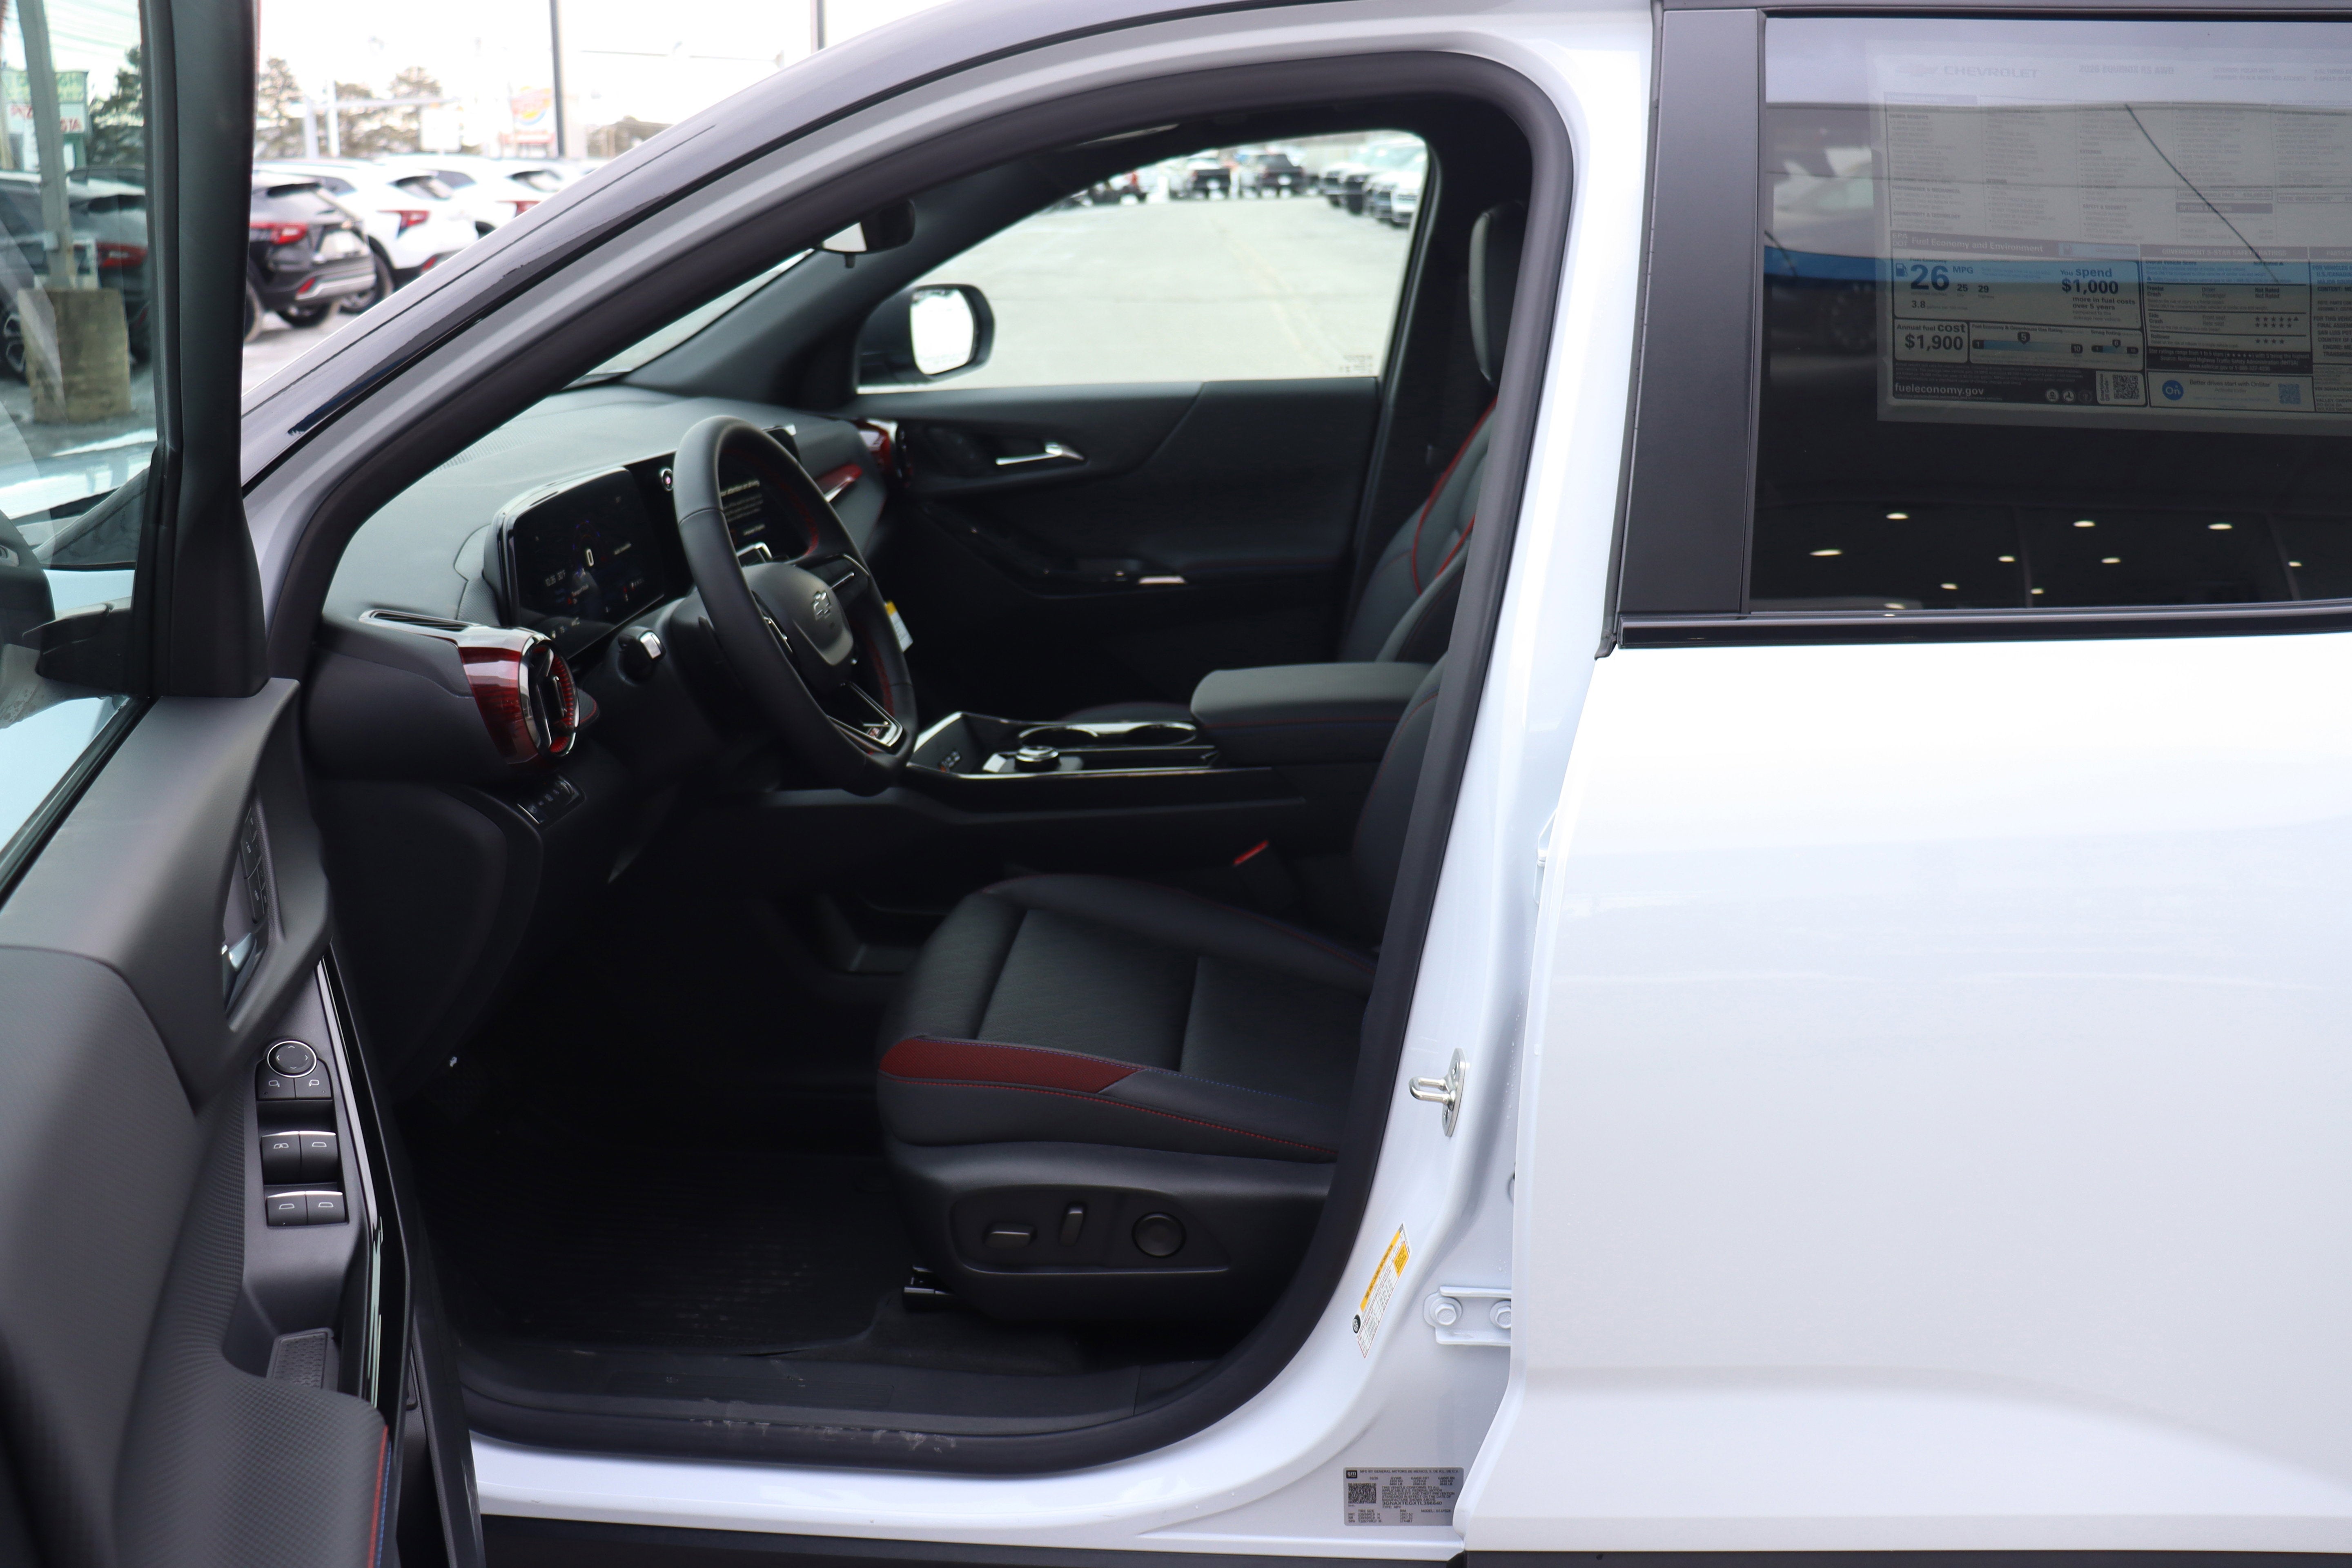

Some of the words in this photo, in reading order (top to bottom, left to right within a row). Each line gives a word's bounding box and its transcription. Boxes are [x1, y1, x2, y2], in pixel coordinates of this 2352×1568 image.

[1944, 65, 2040, 78] CHEVROLET
[2079, 65, 2100, 73] 2026
[2102, 65, 2139, 74] EQUINOX
[2154, 66, 2174, 75] AWD
[1931, 238, 1969, 249] Economy
[1973, 241, 1988, 249] and
[1990, 241, 2043, 252] Environment
[1910, 264, 1950, 292] 26
[1952, 266, 1974, 274] MPG
[2060, 268, 2074, 276] You
[2075, 268, 2113, 278] spend
[1957, 283, 1969, 292] 25
[1978, 284, 1989, 293] 29
[2062, 278, 2119, 295] $1,000
[1911, 300, 1926, 309] 3.8
[1937, 323, 1966, 333] cost
[1904, 332, 1964, 352] $1,900
[2021, 333, 2027, 341] 5
[1895, 382, 1984, 396] fueleconomy.gov
[2165, 385, 2181, 395] On
[586, 548, 595, 566] 0
